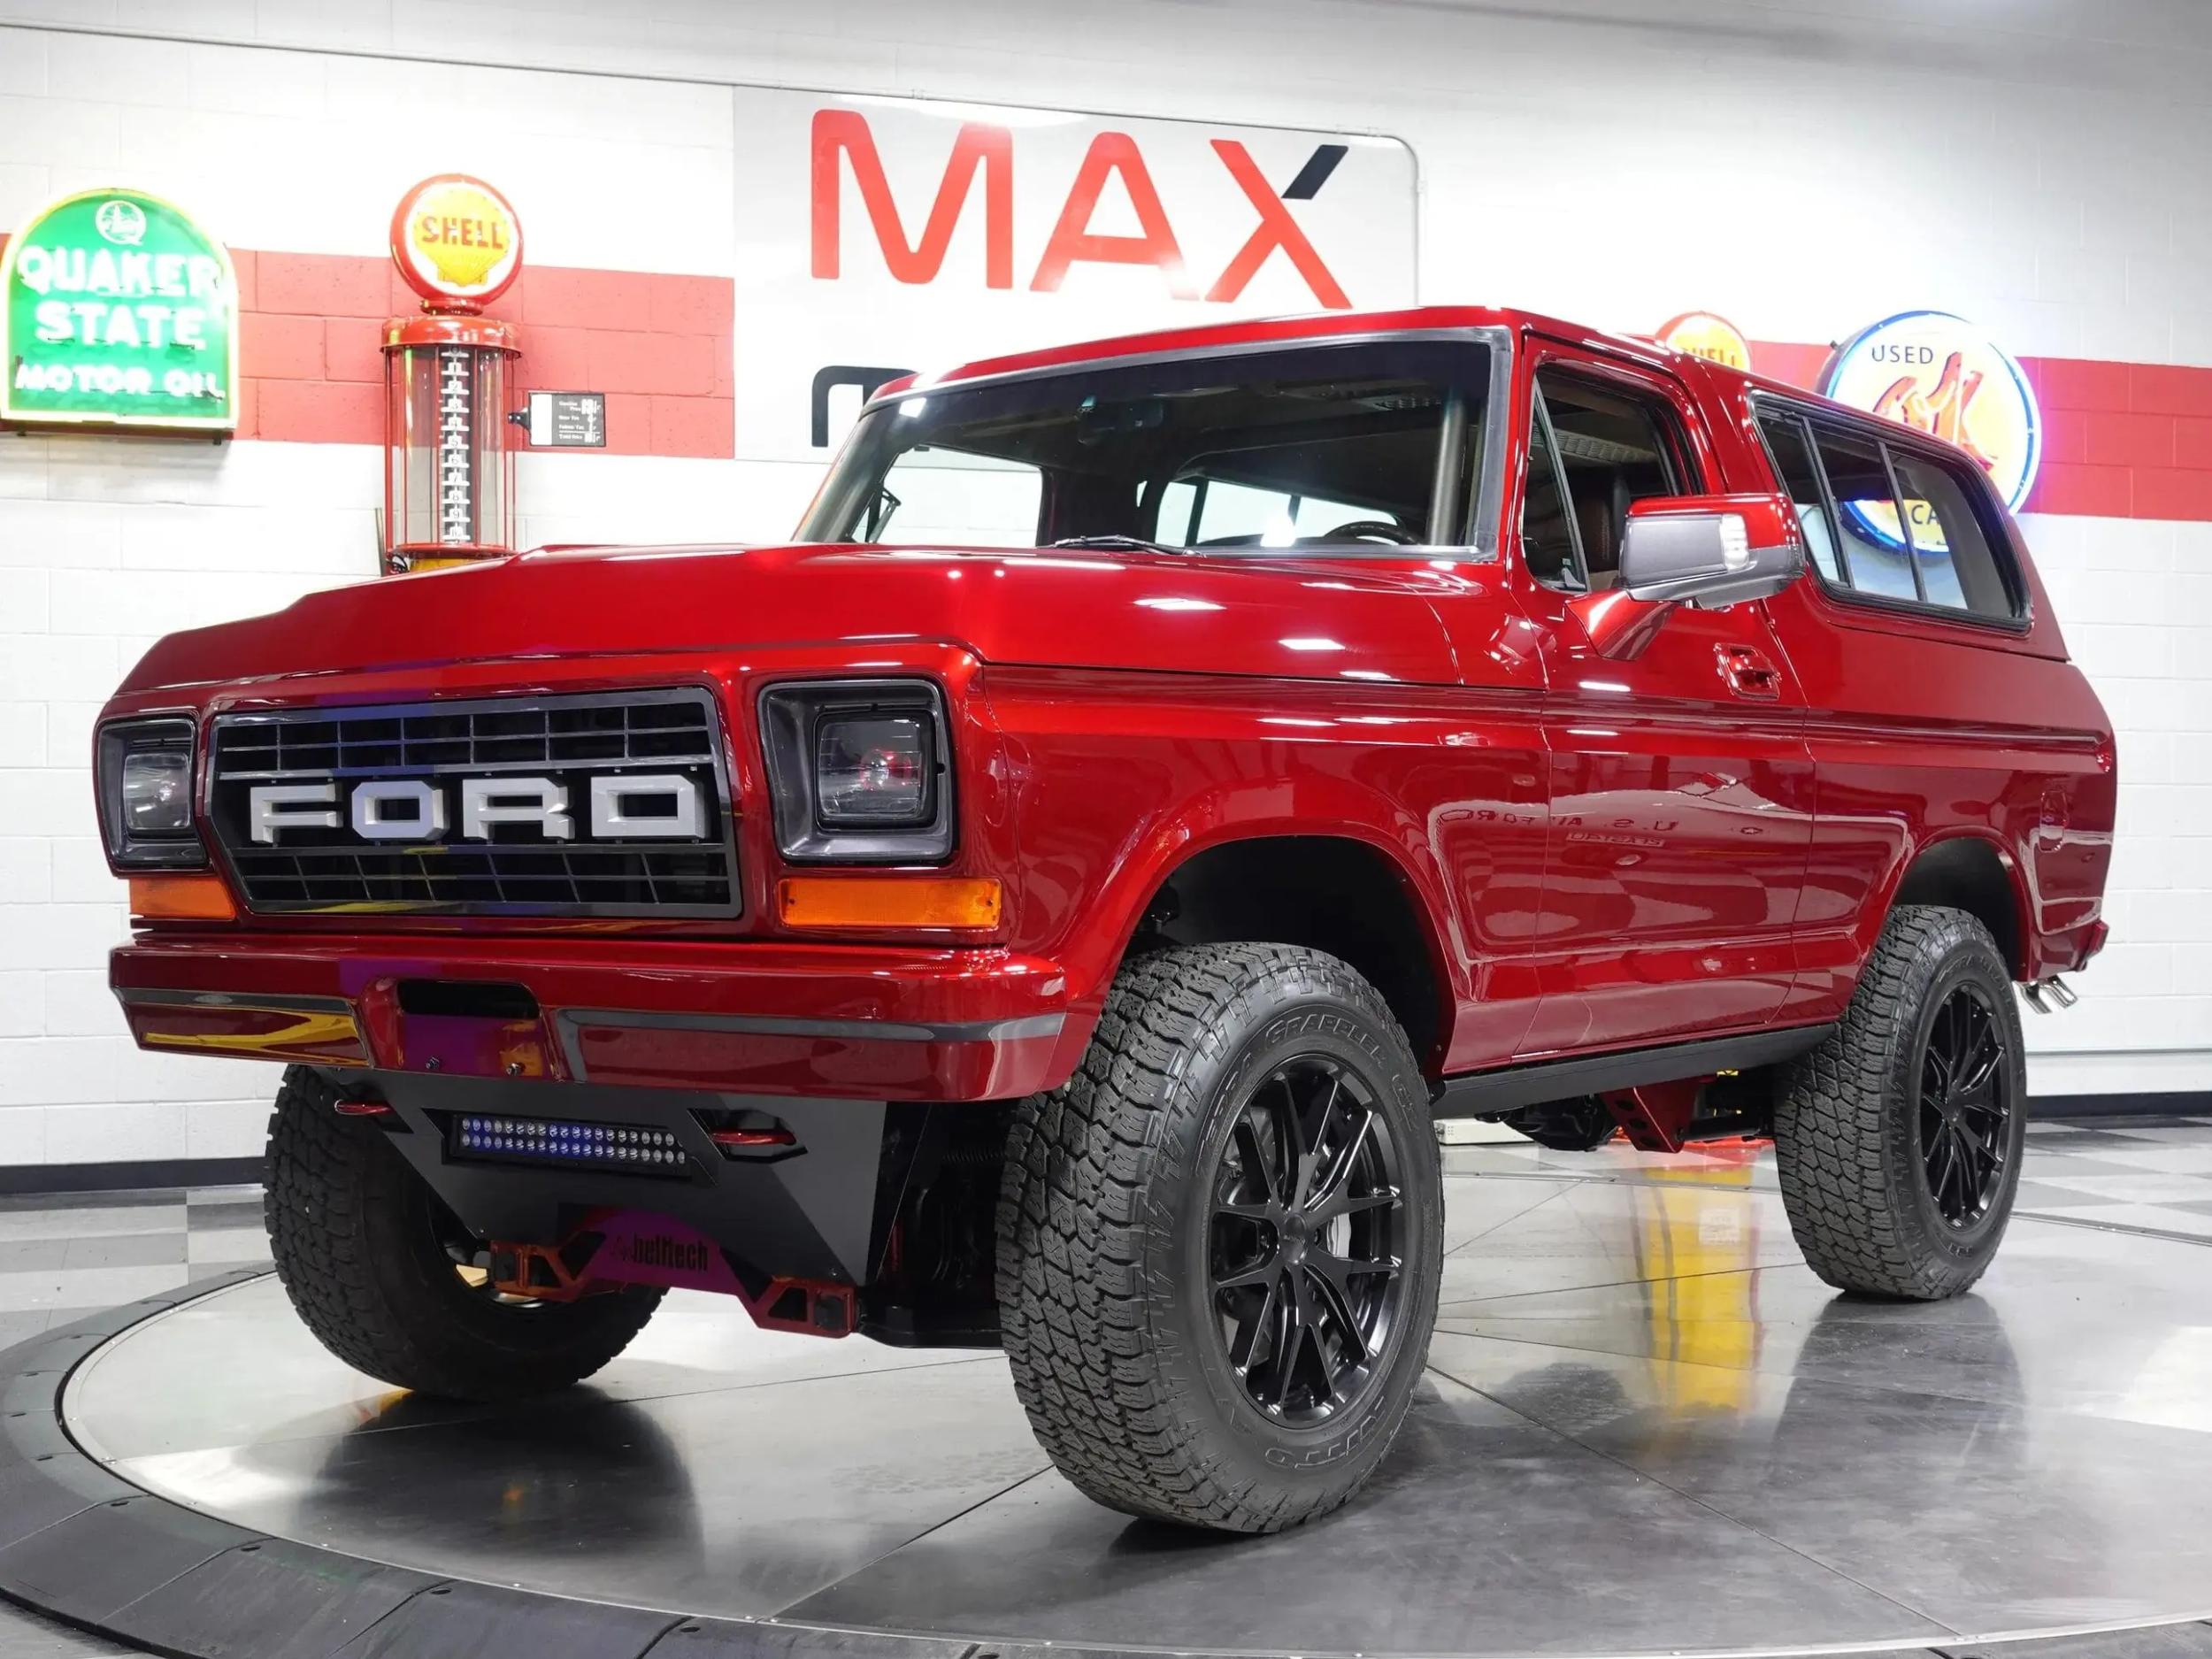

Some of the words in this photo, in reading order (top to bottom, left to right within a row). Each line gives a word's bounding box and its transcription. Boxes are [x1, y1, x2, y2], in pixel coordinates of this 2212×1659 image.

[422, 216, 503, 250] SHELL
[810, 108, 1354, 310] MAX
[16, 245, 222, 297] QUAKER
[35, 299, 206, 350] STATE
[1871, 344, 1934, 365] USED
[15, 364, 152, 394] MOTOR
[164, 368, 226, 399] OIL
[250, 773, 706, 845] FORD
[1265, 1012, 1387, 1070] GRAPPLER
